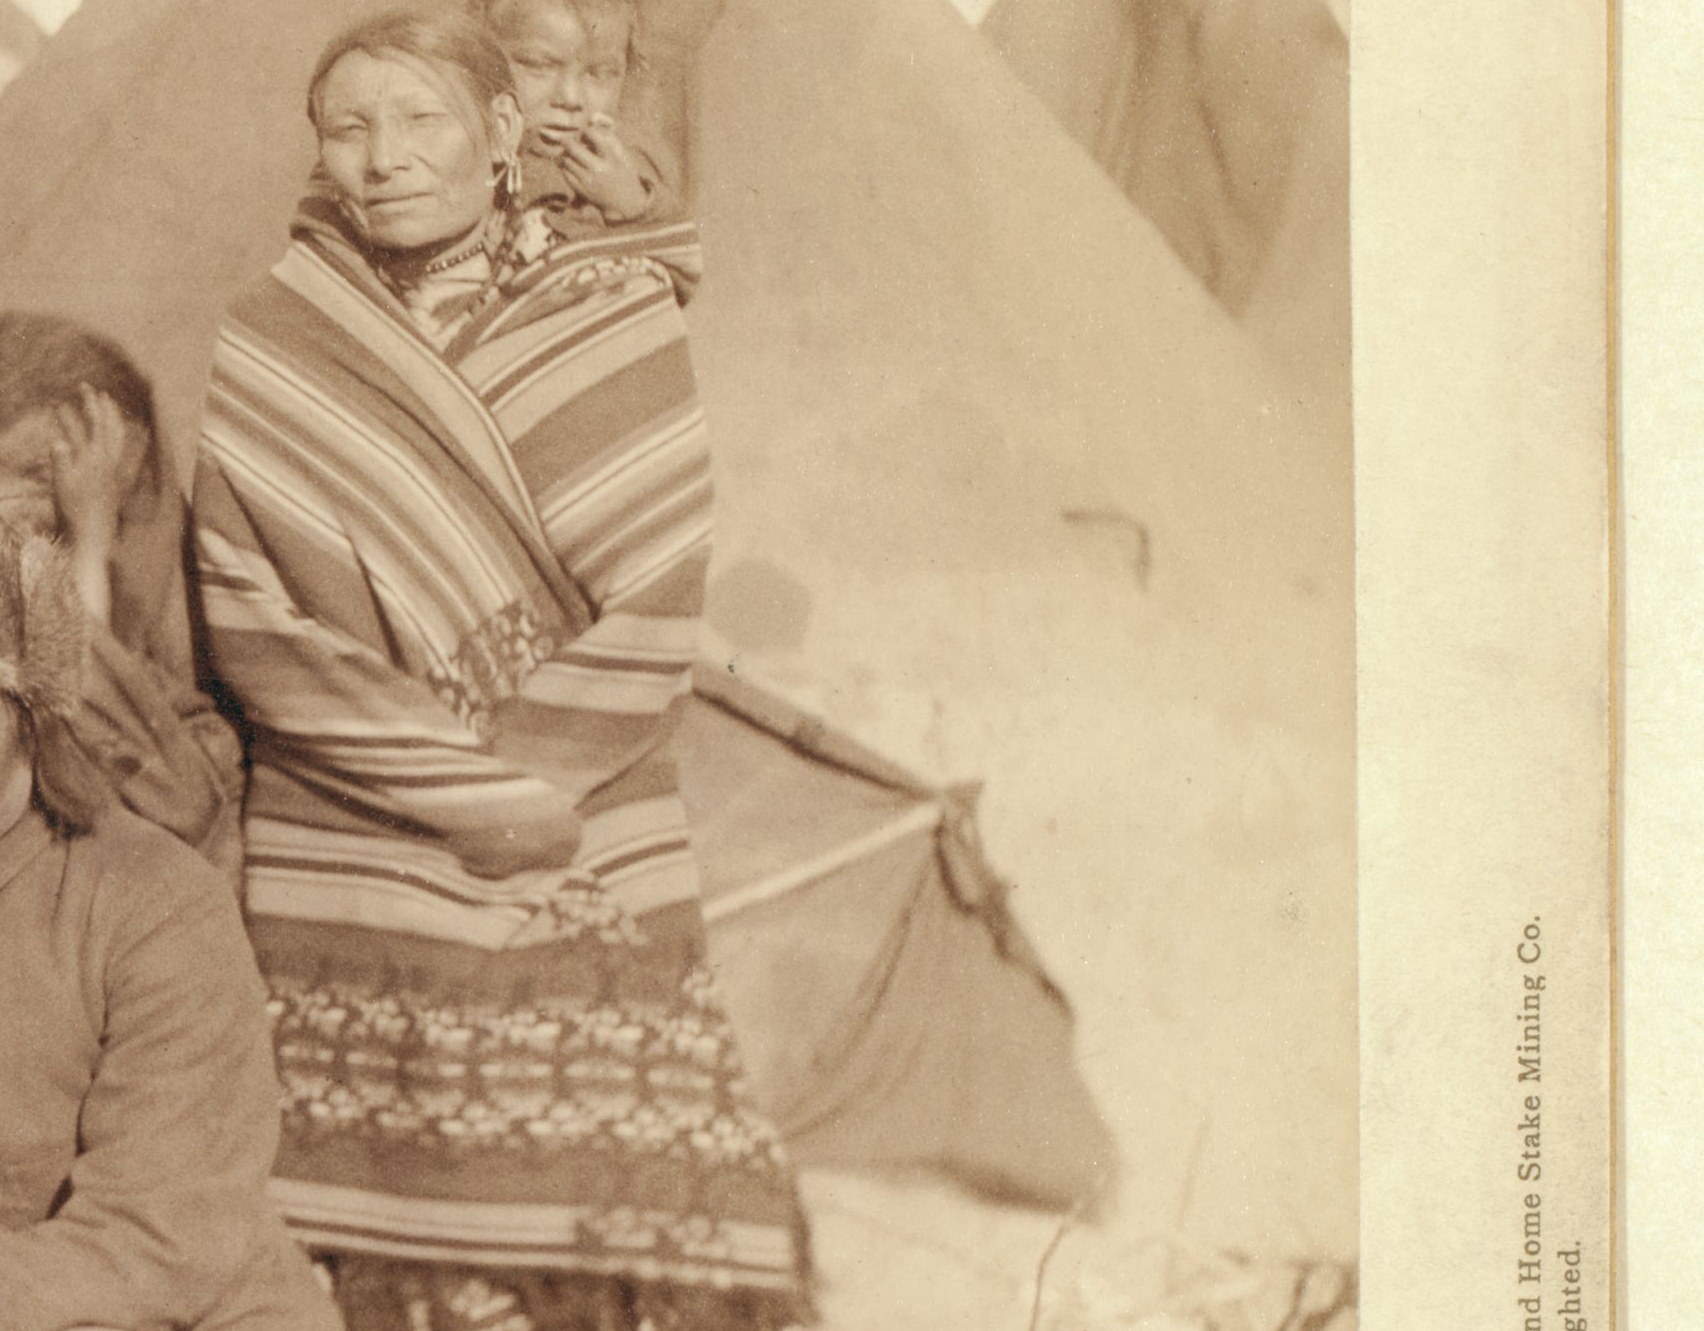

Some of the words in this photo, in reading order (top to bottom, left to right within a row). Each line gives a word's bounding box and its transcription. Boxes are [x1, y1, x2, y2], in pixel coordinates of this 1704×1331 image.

[1516, 916, 1542, 964] Co.
[1516, 975, 1546, 1083] Mining
[1517, 1095, 1542, 1181] Stake
[1517, 1193, 1542, 1284] Home
